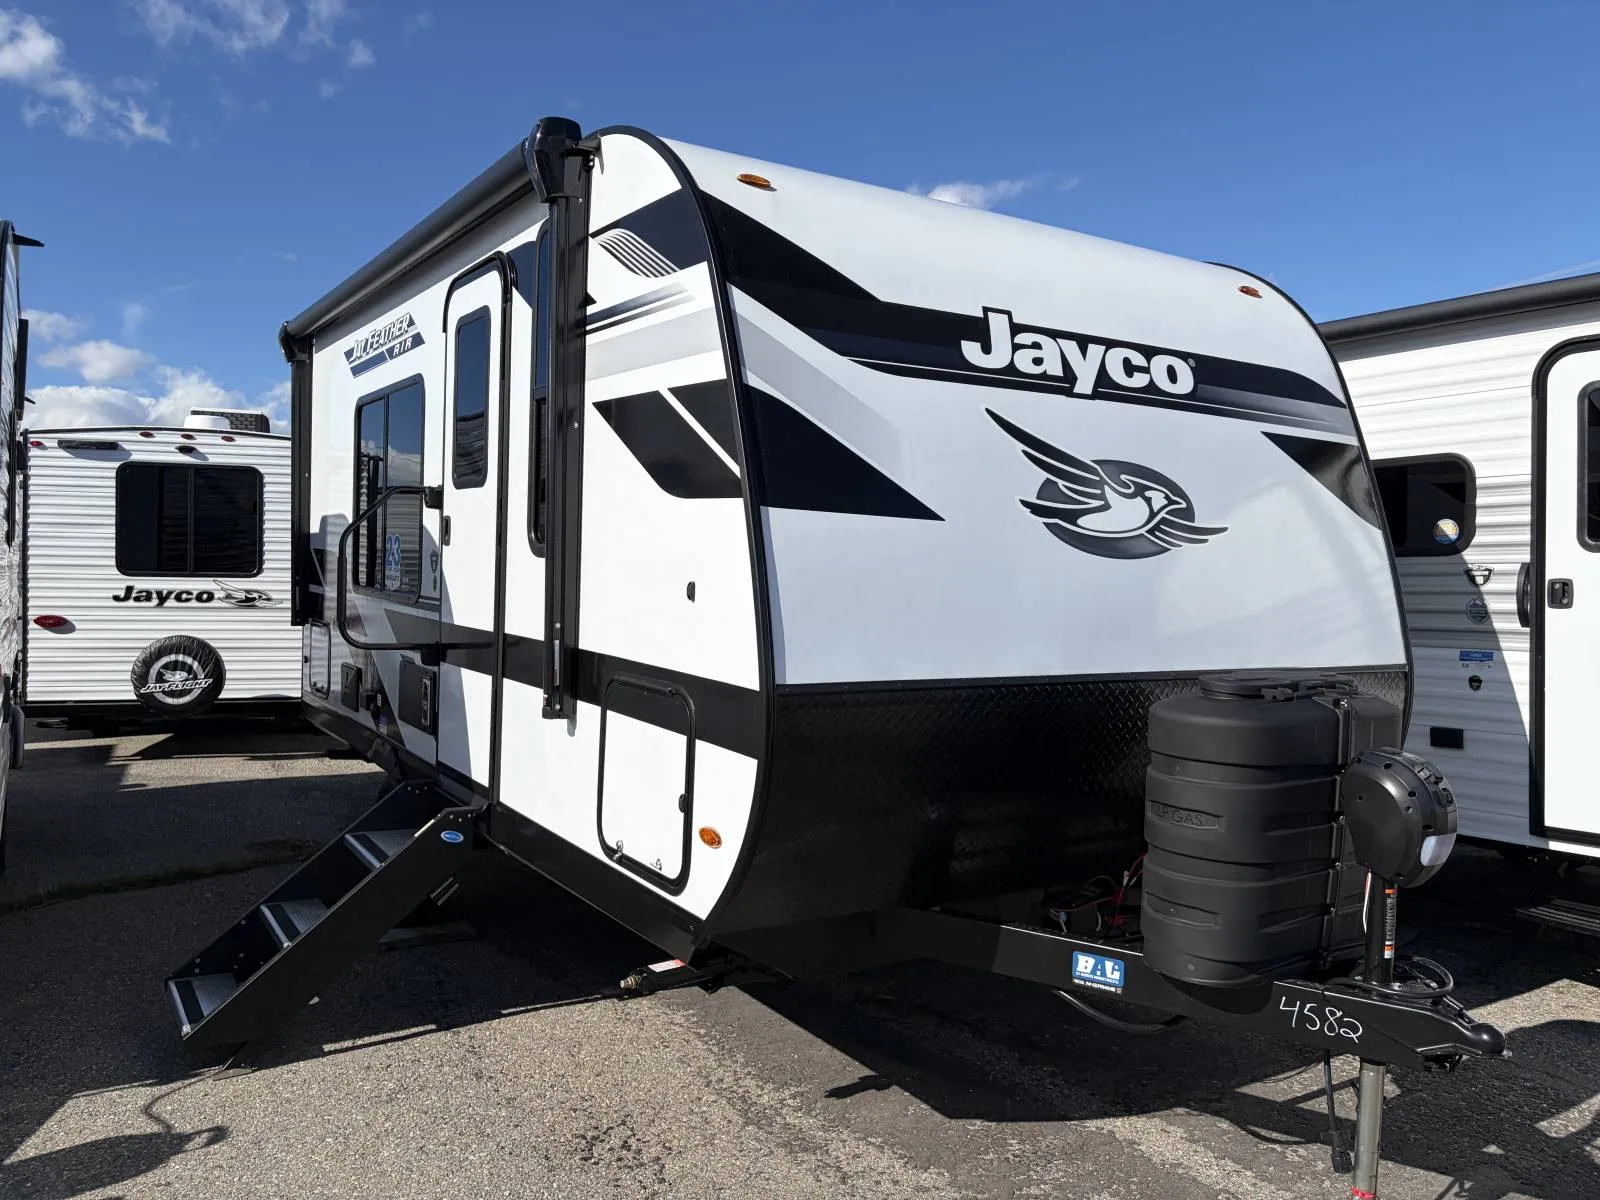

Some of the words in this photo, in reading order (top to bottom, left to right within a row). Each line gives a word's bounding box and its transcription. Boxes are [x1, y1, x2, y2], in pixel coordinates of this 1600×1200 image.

[348, 338, 368, 363] JAY
[366, 312, 411, 354] FEATHER
[393, 337, 413, 357] AIR
[960, 311, 1195, 395] Jayco
[112, 585, 216, 607] Jayco
[1172, 809, 1203, 827] GAS
[1076, 954, 1121, 980] BAL
[1280, 996, 1363, 1043] 4582
